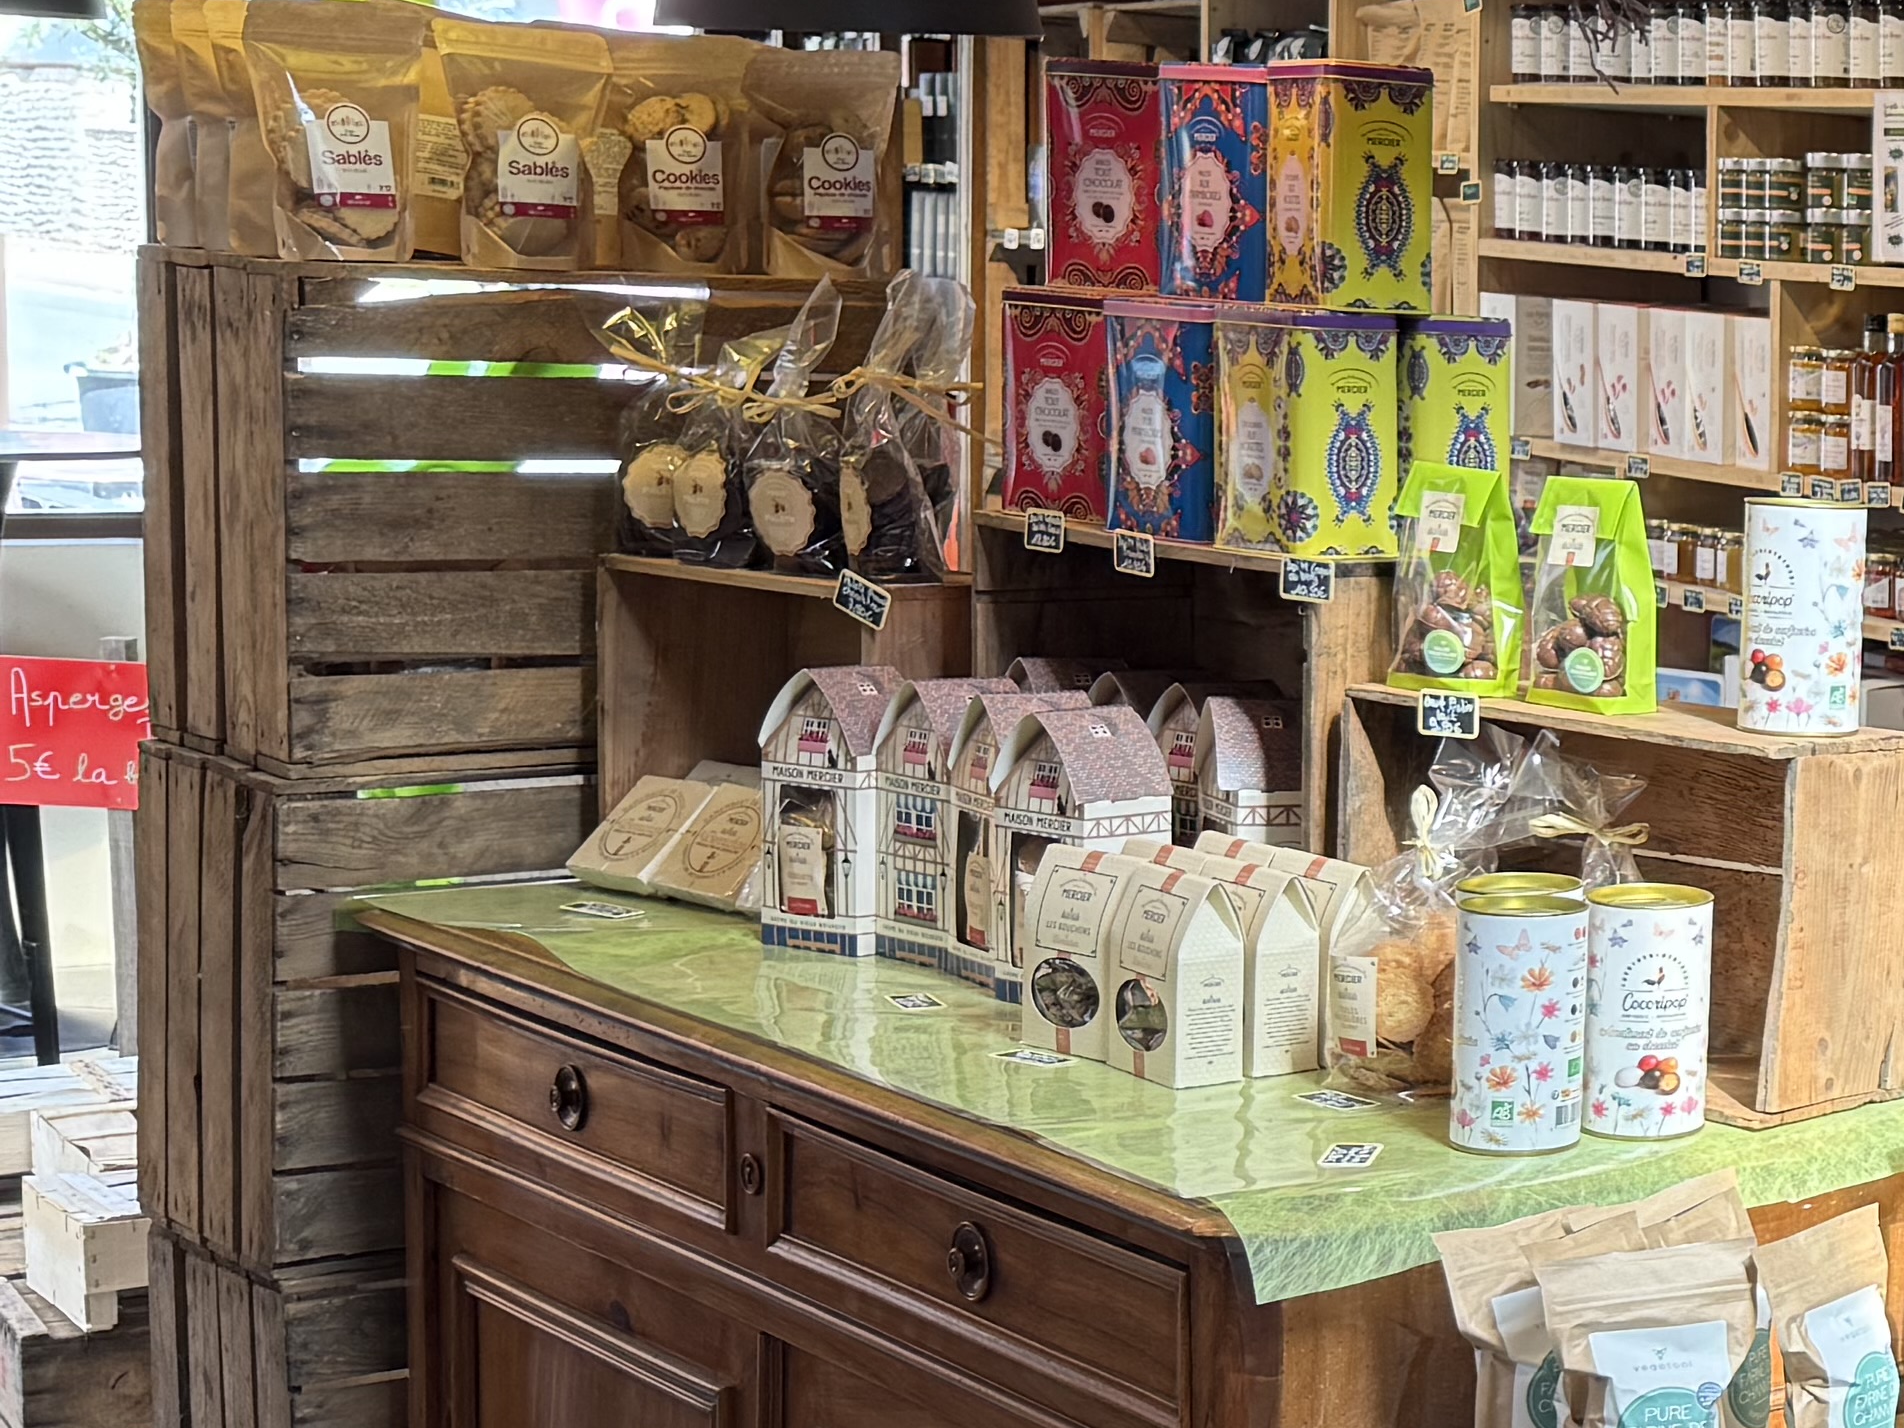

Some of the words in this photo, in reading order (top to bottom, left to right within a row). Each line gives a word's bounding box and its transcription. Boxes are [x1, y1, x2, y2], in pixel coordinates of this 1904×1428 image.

[1366, 137, 1400, 148] MERCIER
[322, 147, 383, 168] Sablés
[508, 159, 570, 180] Sablés
[652, 168, 721, 187] Cookies
[808, 175, 872, 193] Cookies
[1336, 385, 1368, 395] MERCIER
[1457, 388, 1486, 397] MERCIER
[1428, 510, 1456, 521] MERCIER
[1561, 523, 1590, 534] MERCIER
[11, 667, 149, 728] Asperge
[5, 744, 60, 782] 5€
[73, 753, 118, 785] la
[772, 765, 804, 780] MAISON
[806, 769, 843, 784] MERCIER
[1004, 812, 1034, 827] MAISON
[1036, 816, 1072, 832] MERCIER
[1645, 1404, 1693, 1423] PURE
